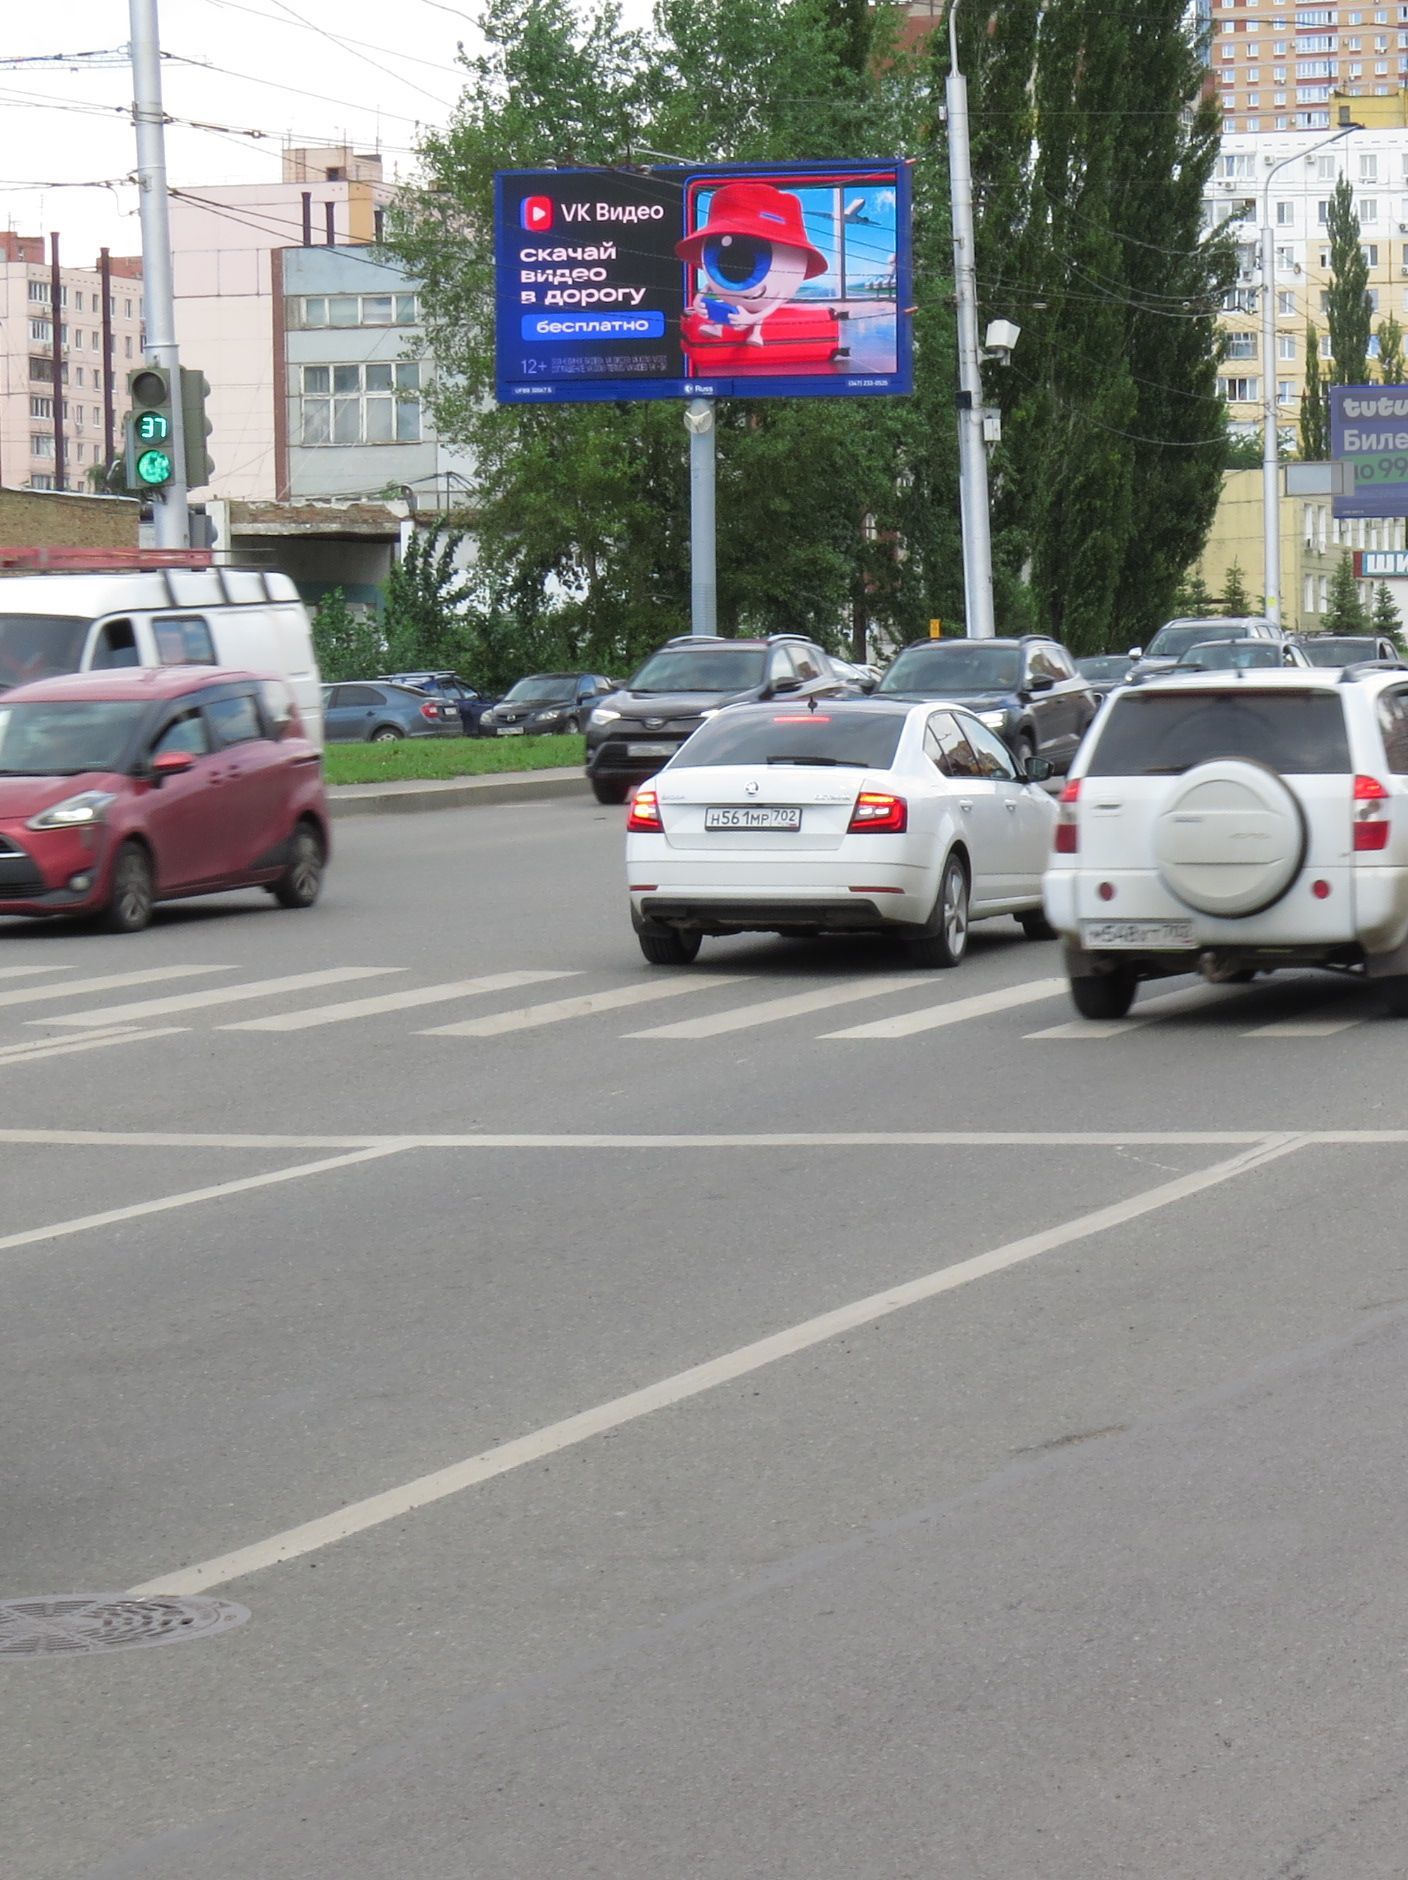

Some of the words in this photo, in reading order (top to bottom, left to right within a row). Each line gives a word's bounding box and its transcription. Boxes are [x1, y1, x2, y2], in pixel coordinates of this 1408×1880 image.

[561, 204, 591, 222] VK
[596, 203, 664, 223] Видео
[520, 241, 617, 262] скачай
[521, 267, 607, 284] видео
[521, 290, 537, 304] в
[544, 288, 646, 306] дорогу
[536, 320, 649, 333] бесплатно
[521, 359, 547, 374] 12+
[141, 416, 166, 438] 37
